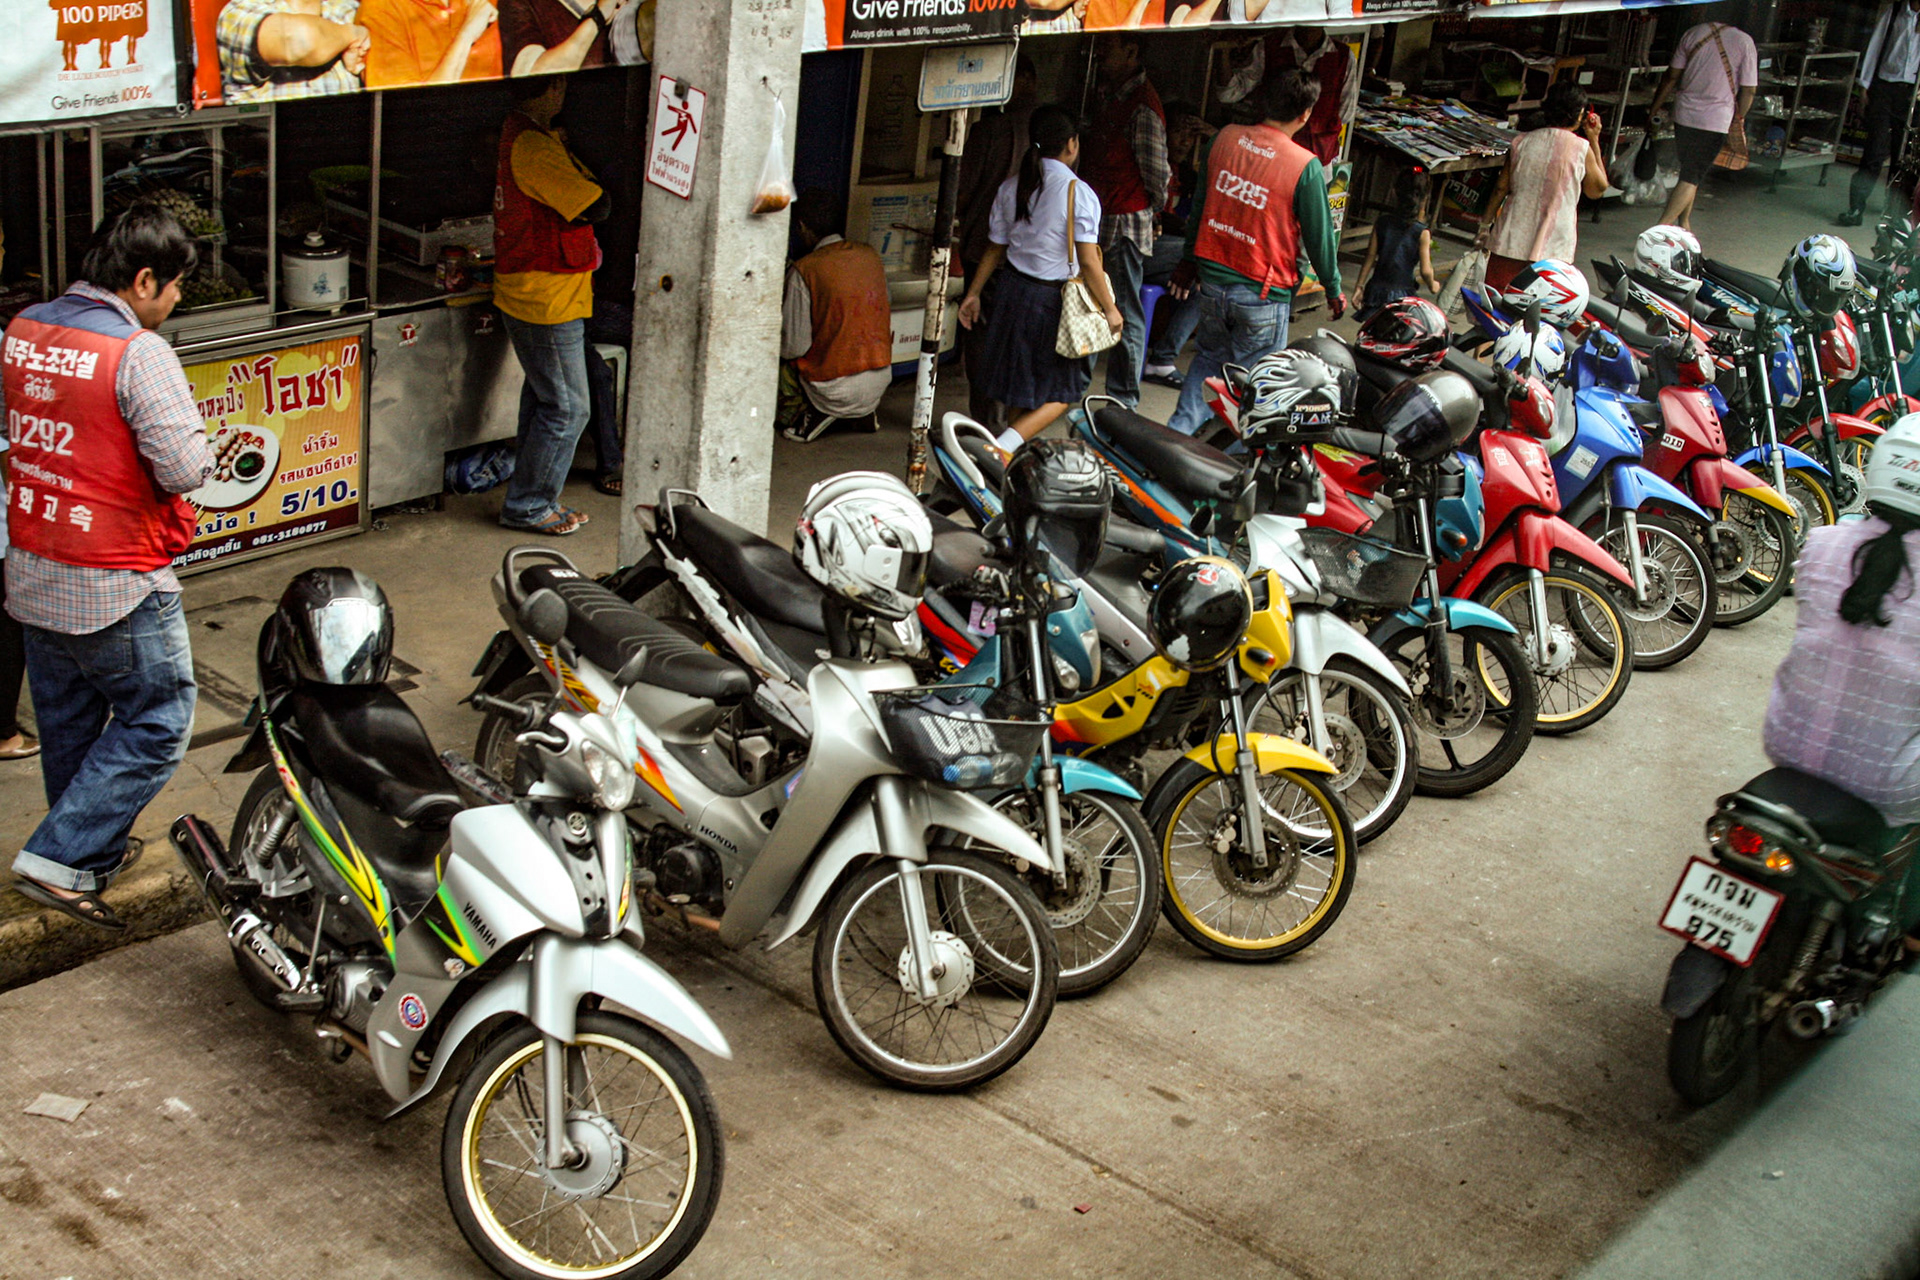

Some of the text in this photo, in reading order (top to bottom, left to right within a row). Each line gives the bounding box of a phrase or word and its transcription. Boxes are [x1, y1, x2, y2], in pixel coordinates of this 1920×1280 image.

[62, 2, 144, 24] 100 PIPERS
[852, 0, 898, 20] Give
[903, 0, 965, 17] Friends
[851, 29, 875, 39] Always
[877, 29, 894, 38] drink
[897, 28, 910, 37] with
[912, 26, 930, 35] 100%
[51, 85, 152, 111] Give Friends 100%
[1215, 169, 1269, 210] 0285
[9, 408, 74, 456] 0292
[303, 431, 338, 455] น้ำจิ้ม
[699, 825, 738, 854] HONDA
[463, 901, 497, 950] YAMAHA
[1685, 914, 1736, 951] 875
